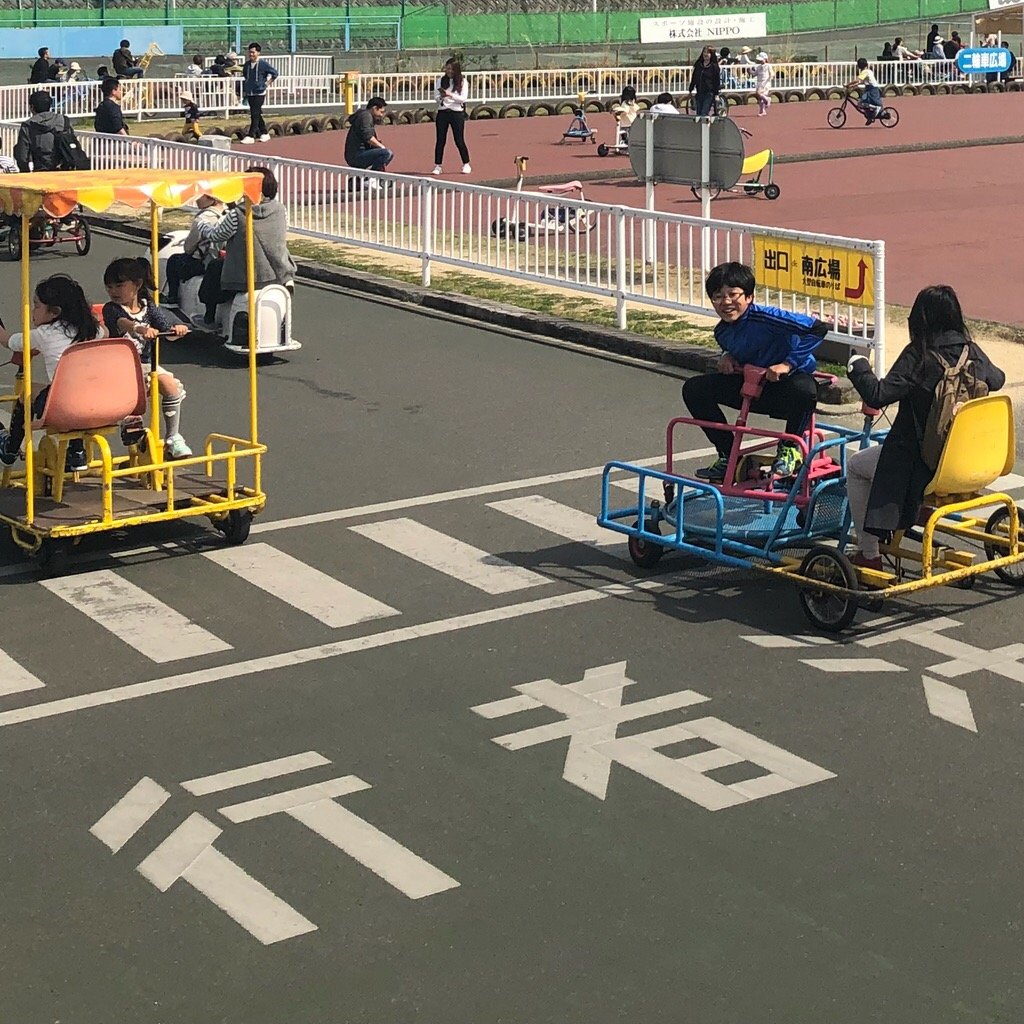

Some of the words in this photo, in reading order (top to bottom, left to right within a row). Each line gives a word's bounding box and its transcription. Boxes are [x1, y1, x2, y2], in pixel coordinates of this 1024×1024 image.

[669, 27, 702, 38] 株式会社
[707, 26, 740, 36] NIPPO
[962, 52, 1007, 68] 二輪車広場
[764, 249, 788, 272] 出口
[802, 255, 840, 281] 南広場
